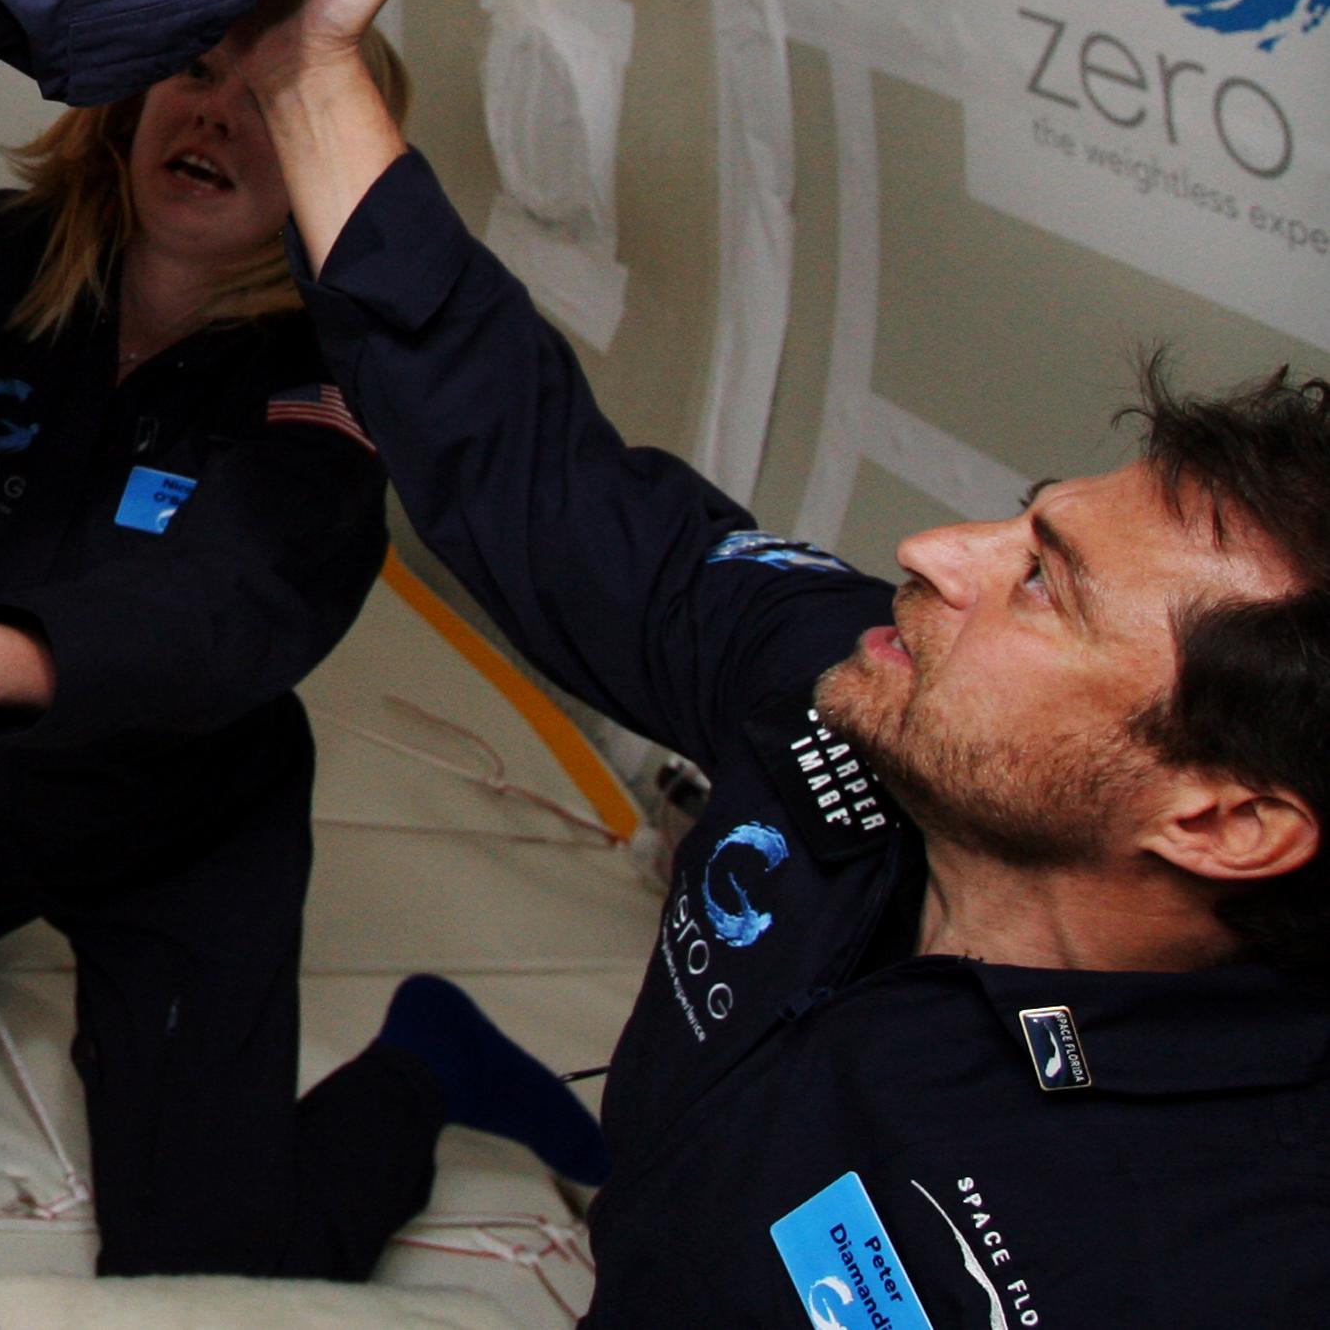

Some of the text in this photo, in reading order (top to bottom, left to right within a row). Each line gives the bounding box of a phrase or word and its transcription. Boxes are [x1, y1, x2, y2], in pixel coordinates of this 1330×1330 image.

[1016, 6, 1294, 180] zero
[1248, 204, 1330, 256] expe
[672, 882, 734, 1020] ero G
[957, 1176, 1012, 1266] SPACE
[863, 1235, 904, 1303] Peter
